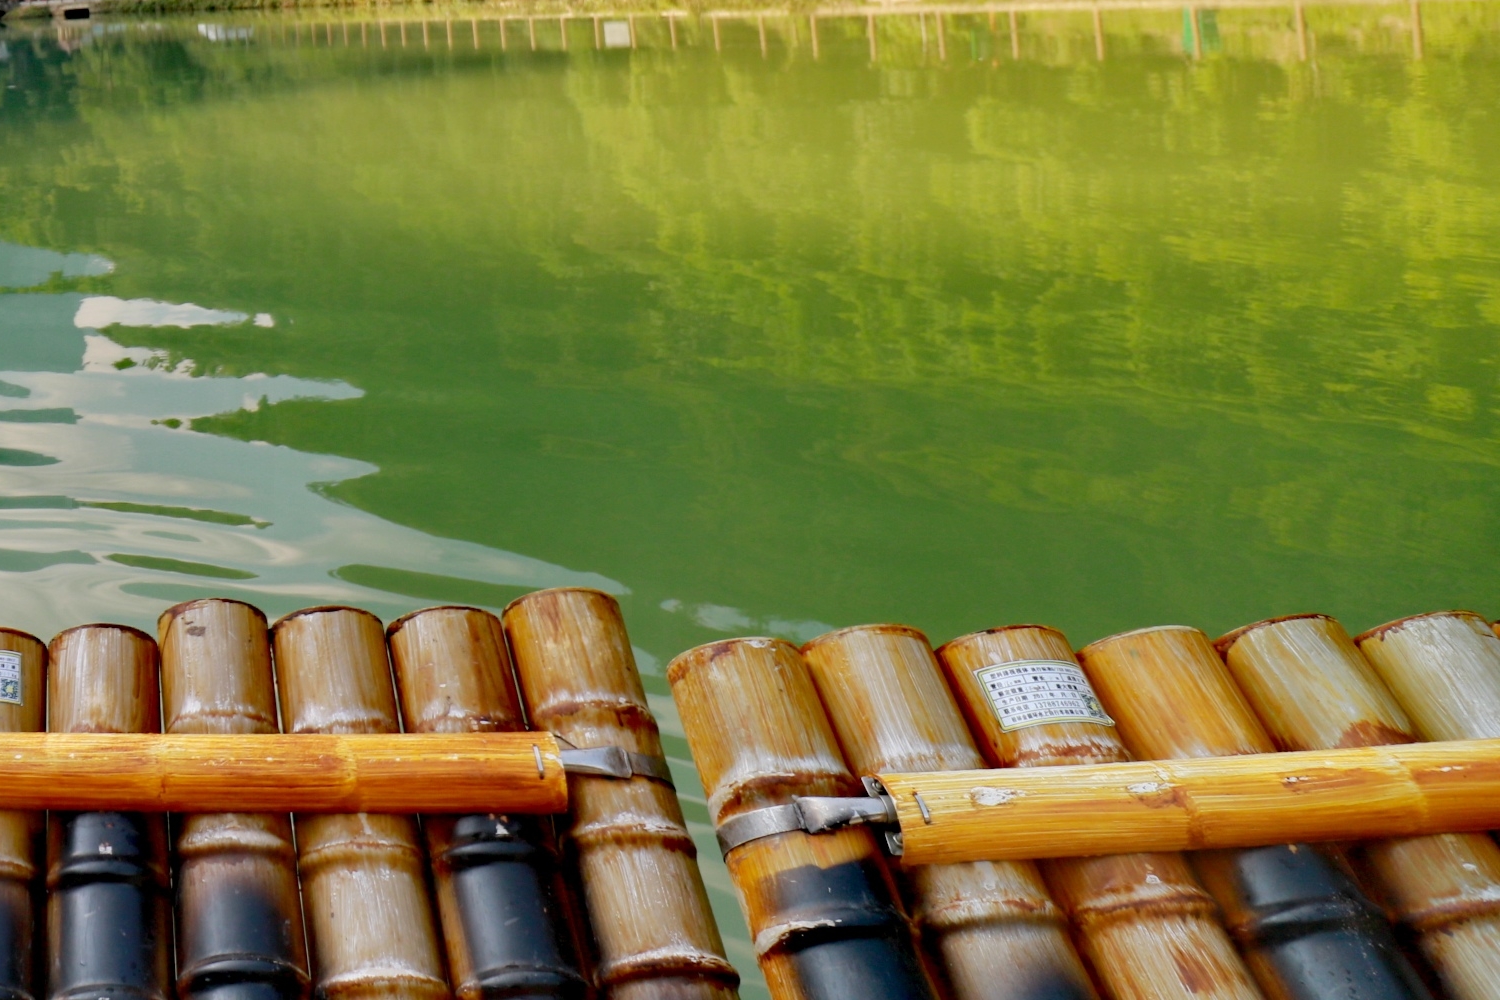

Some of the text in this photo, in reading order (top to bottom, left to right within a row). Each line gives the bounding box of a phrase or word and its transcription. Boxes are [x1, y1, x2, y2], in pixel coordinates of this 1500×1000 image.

[1001, 695, 1029, 705] 生产日期
[1034, 701, 1081, 709] 13788746962
